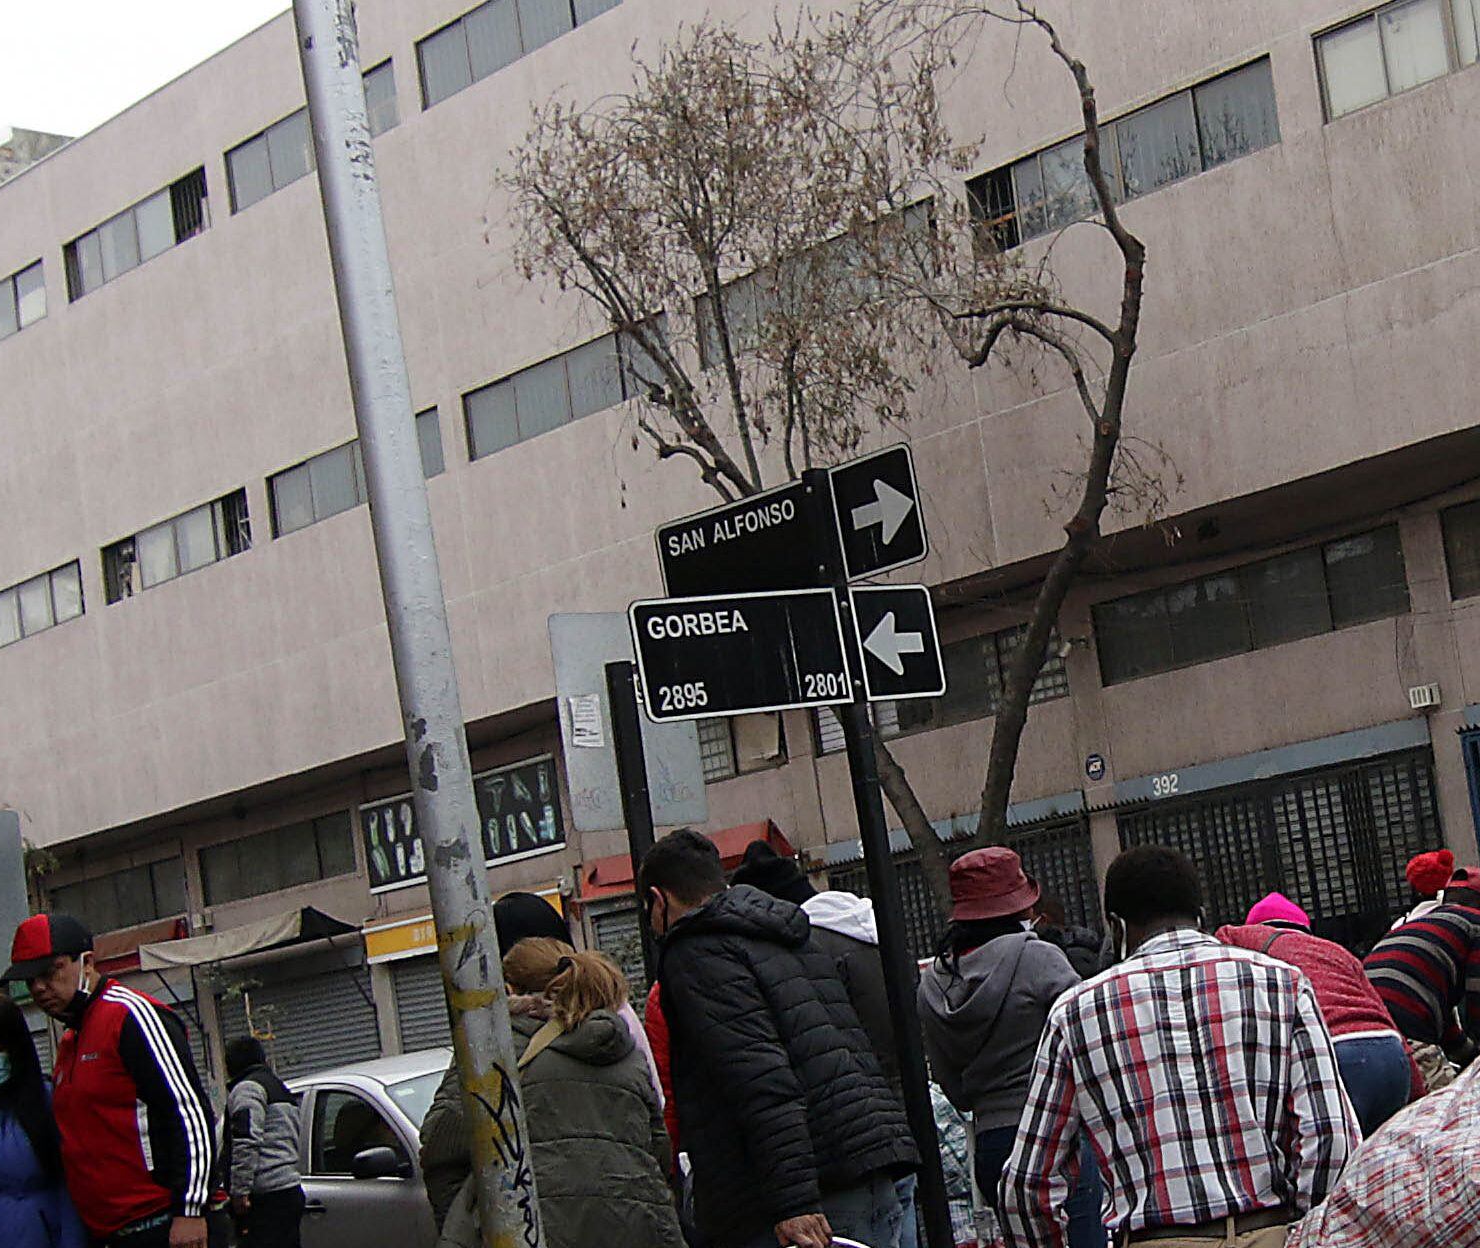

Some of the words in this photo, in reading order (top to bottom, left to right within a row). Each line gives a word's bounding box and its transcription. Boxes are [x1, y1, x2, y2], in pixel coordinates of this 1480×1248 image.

[668, 526, 706, 557] SAN
[713, 499, 795, 544] ALFONSO
[646, 609, 749, 640] GORBEA
[658, 681, 708, 711] 2895
[804, 672, 847, 699] 2801
[1152, 773, 1179, 797] 392
